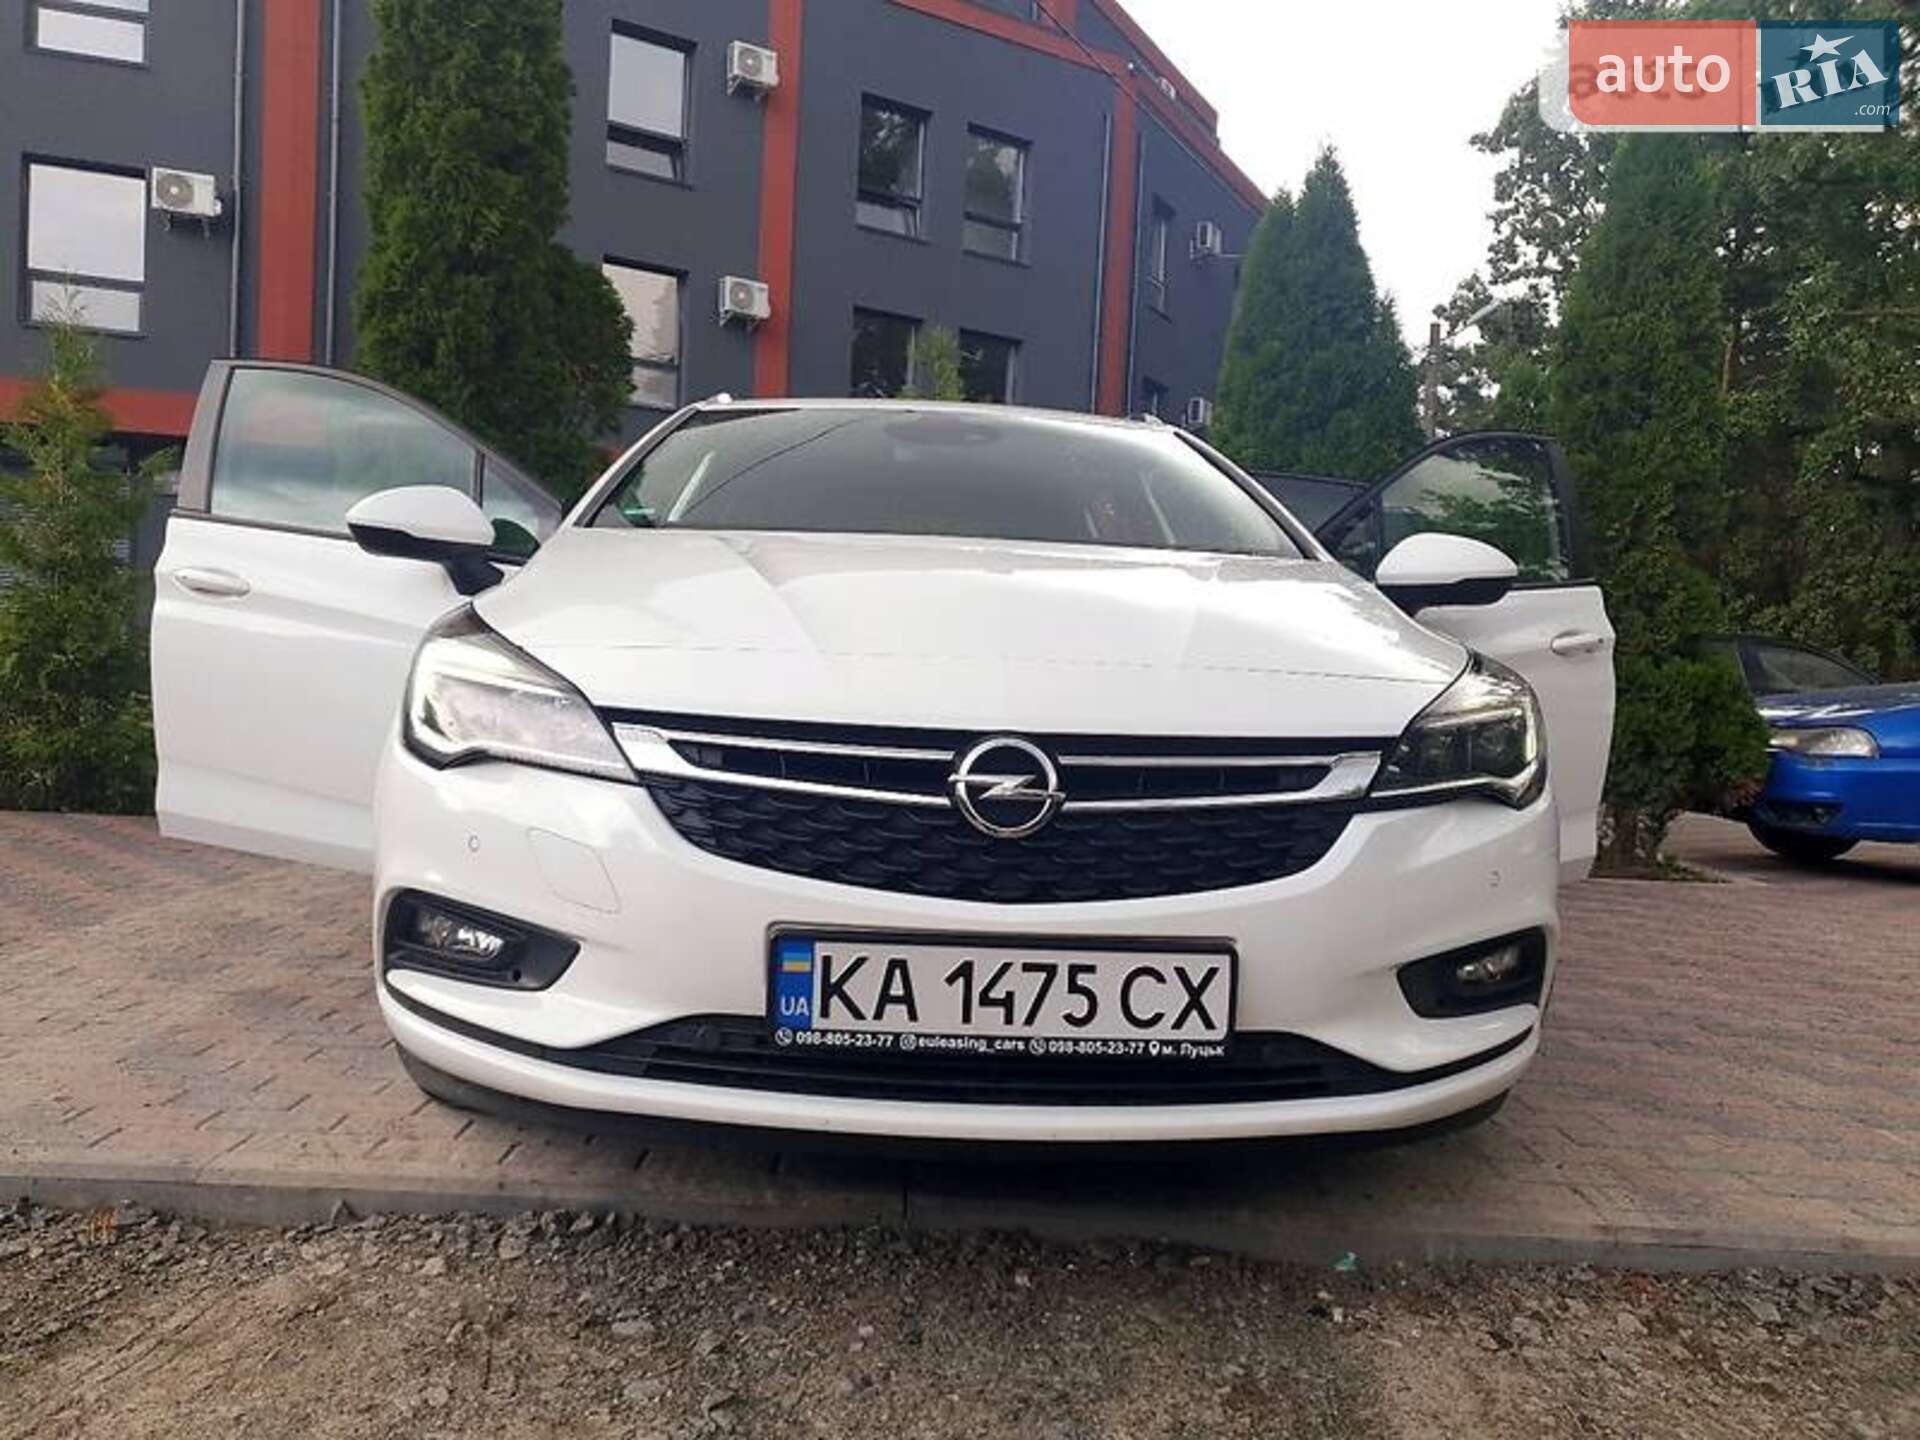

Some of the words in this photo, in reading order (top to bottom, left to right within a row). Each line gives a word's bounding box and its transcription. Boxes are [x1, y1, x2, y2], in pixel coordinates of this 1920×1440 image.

[818, 954, 919, 1023] KA
[944, 960, 1098, 1027] 1475
[1120, 965, 1222, 1031] CX
[780, 997, 810, 1018] UA
[795, 1031, 894, 1048] 098-805-23-77
